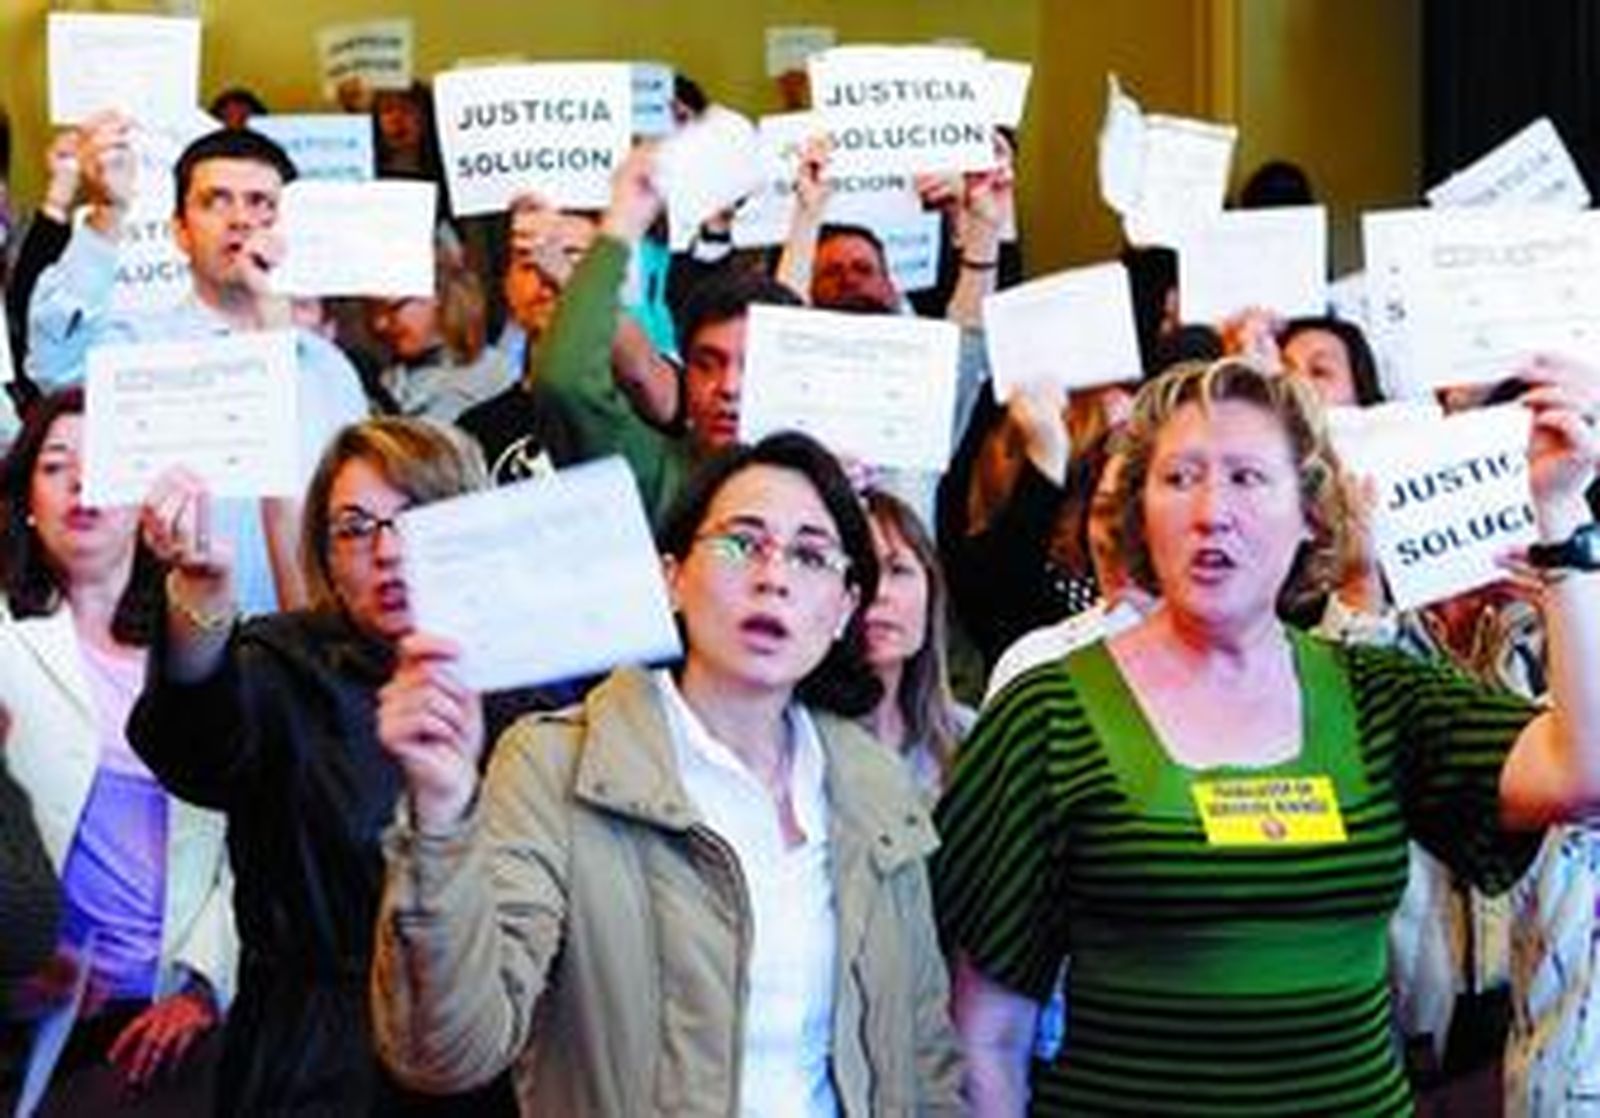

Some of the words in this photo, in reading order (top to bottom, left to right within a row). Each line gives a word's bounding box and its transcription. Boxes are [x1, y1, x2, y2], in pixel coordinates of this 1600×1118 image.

[826, 80, 975, 106] JUSTICIA
[458, 100, 610, 130] JUSTICIA
[458, 147, 612, 177] SOLUCION
